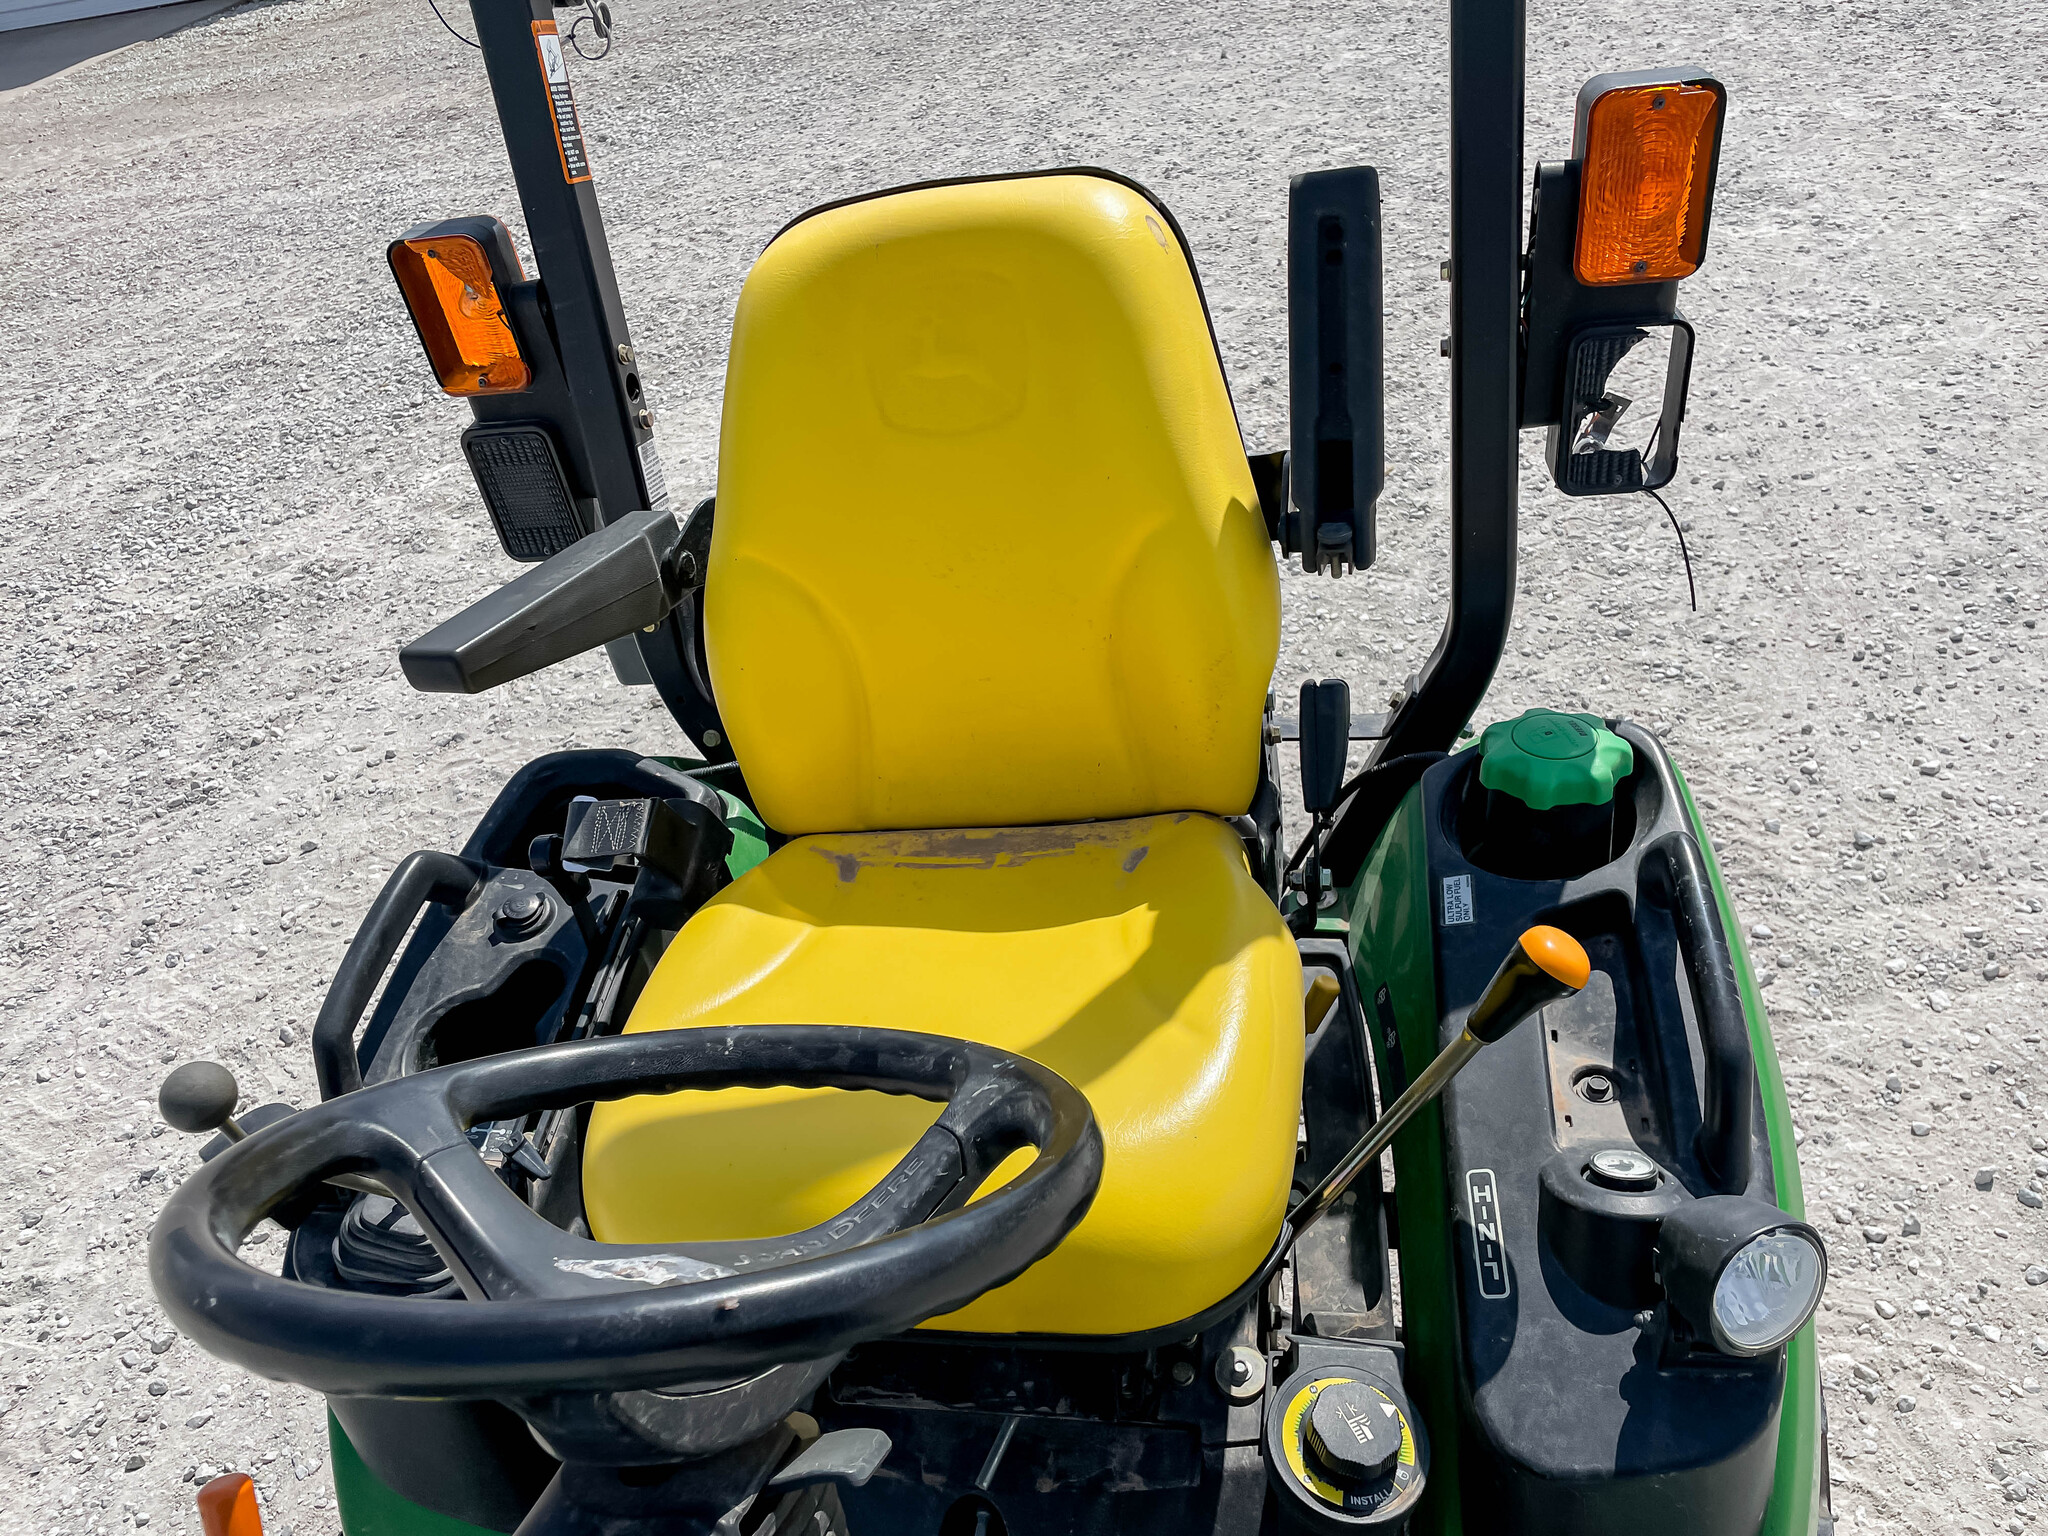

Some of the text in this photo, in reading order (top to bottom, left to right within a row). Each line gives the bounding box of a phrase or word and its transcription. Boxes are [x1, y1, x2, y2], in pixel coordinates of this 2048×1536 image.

[1446, 884, 1455, 922] ULTRA LOW
[1454, 895, 1463, 921] SULFUR
[1462, 903, 1470, 920] ONLY
[828, 1157, 925, 1240] DEERE
[1350, 1488, 1393, 1506] INSTALL
